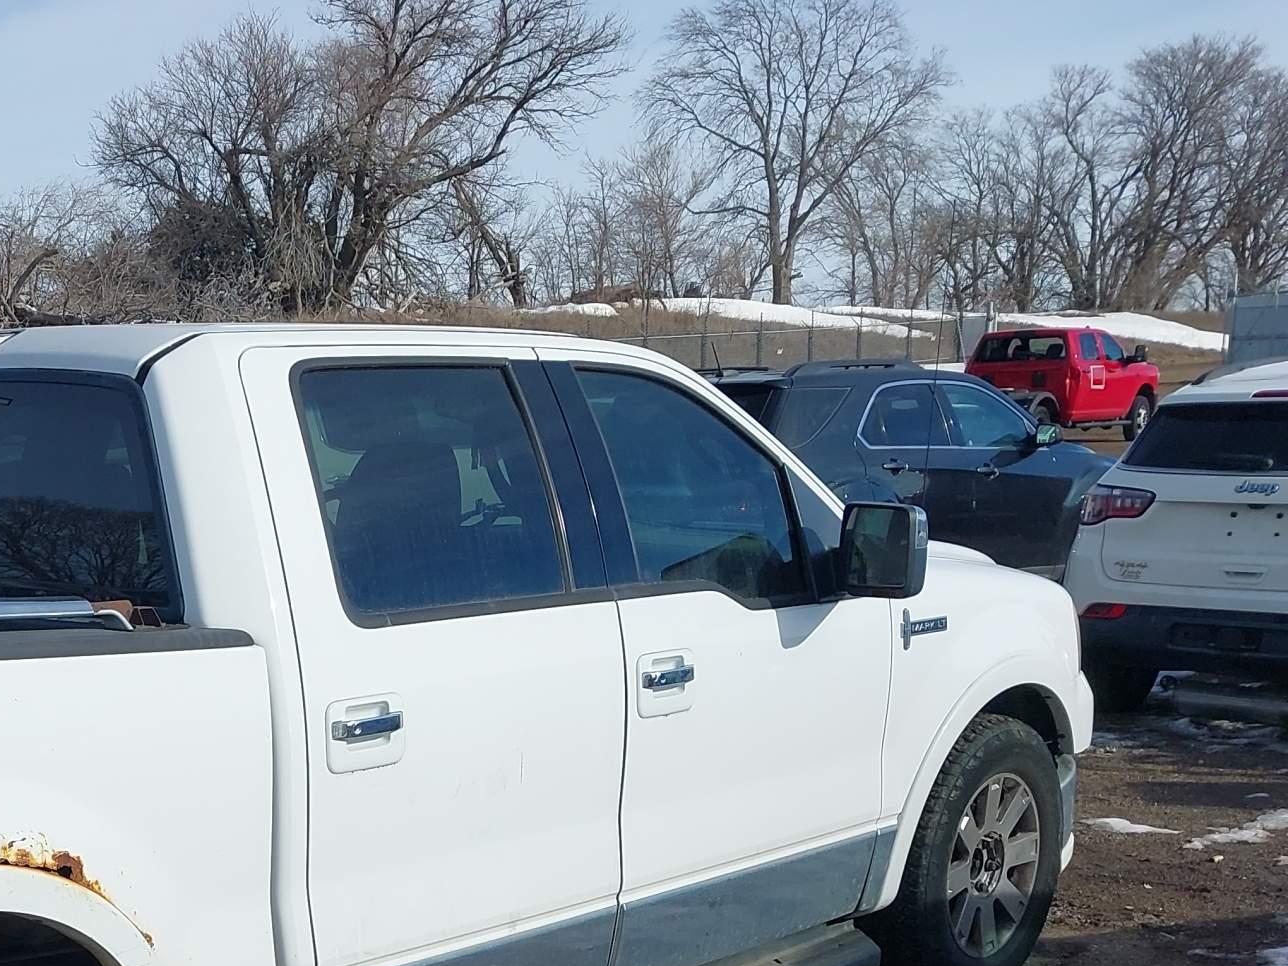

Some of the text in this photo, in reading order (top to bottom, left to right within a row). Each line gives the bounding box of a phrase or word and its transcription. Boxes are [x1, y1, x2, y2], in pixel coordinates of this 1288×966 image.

[1234, 480, 1280, 496] Jeep
[911, 619, 946, 632] MARK LT
